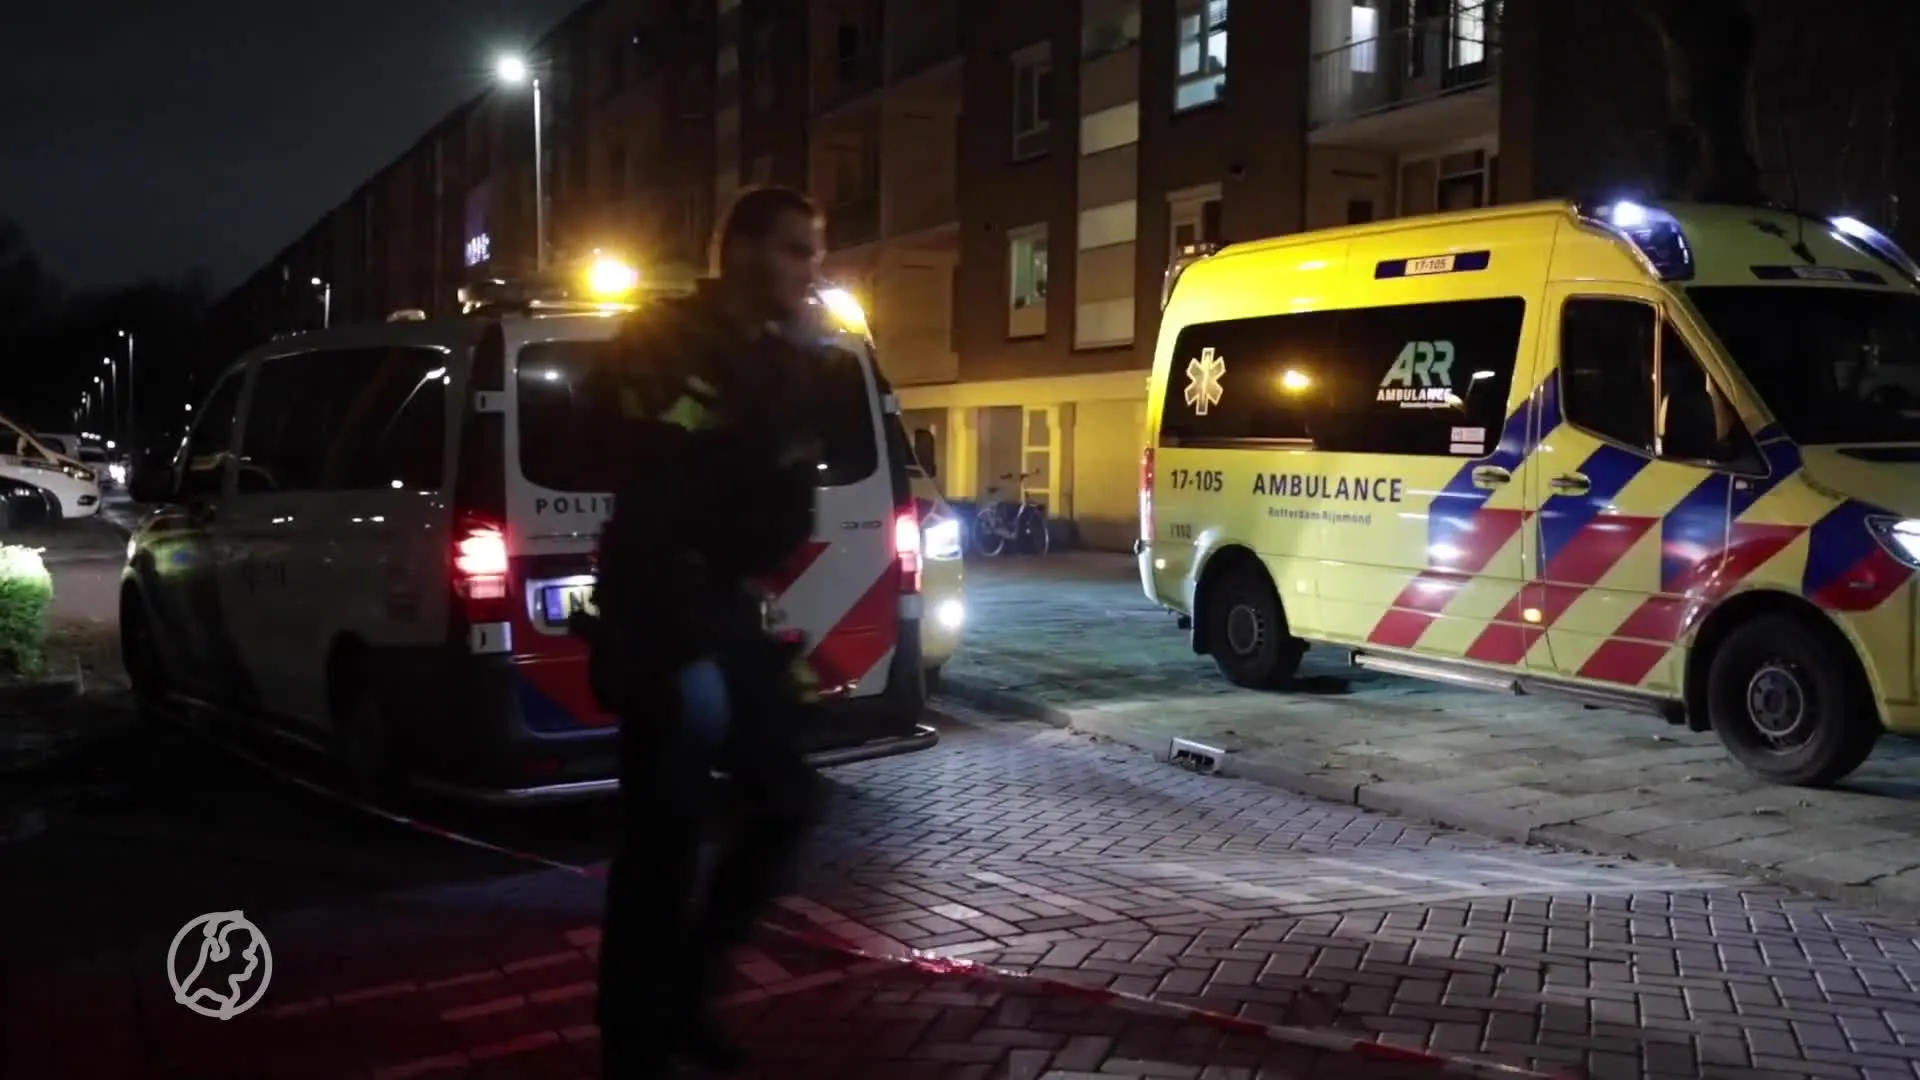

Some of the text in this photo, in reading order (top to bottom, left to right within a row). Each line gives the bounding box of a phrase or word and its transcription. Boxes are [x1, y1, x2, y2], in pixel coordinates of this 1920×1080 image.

[1414, 259, 1447, 271] 17-105
[1379, 341, 1455, 387] ARR
[1171, 469, 1223, 492] 17-105
[1252, 473, 1403, 503] AMBULANCE
[536, 497, 616, 515] POLIT
